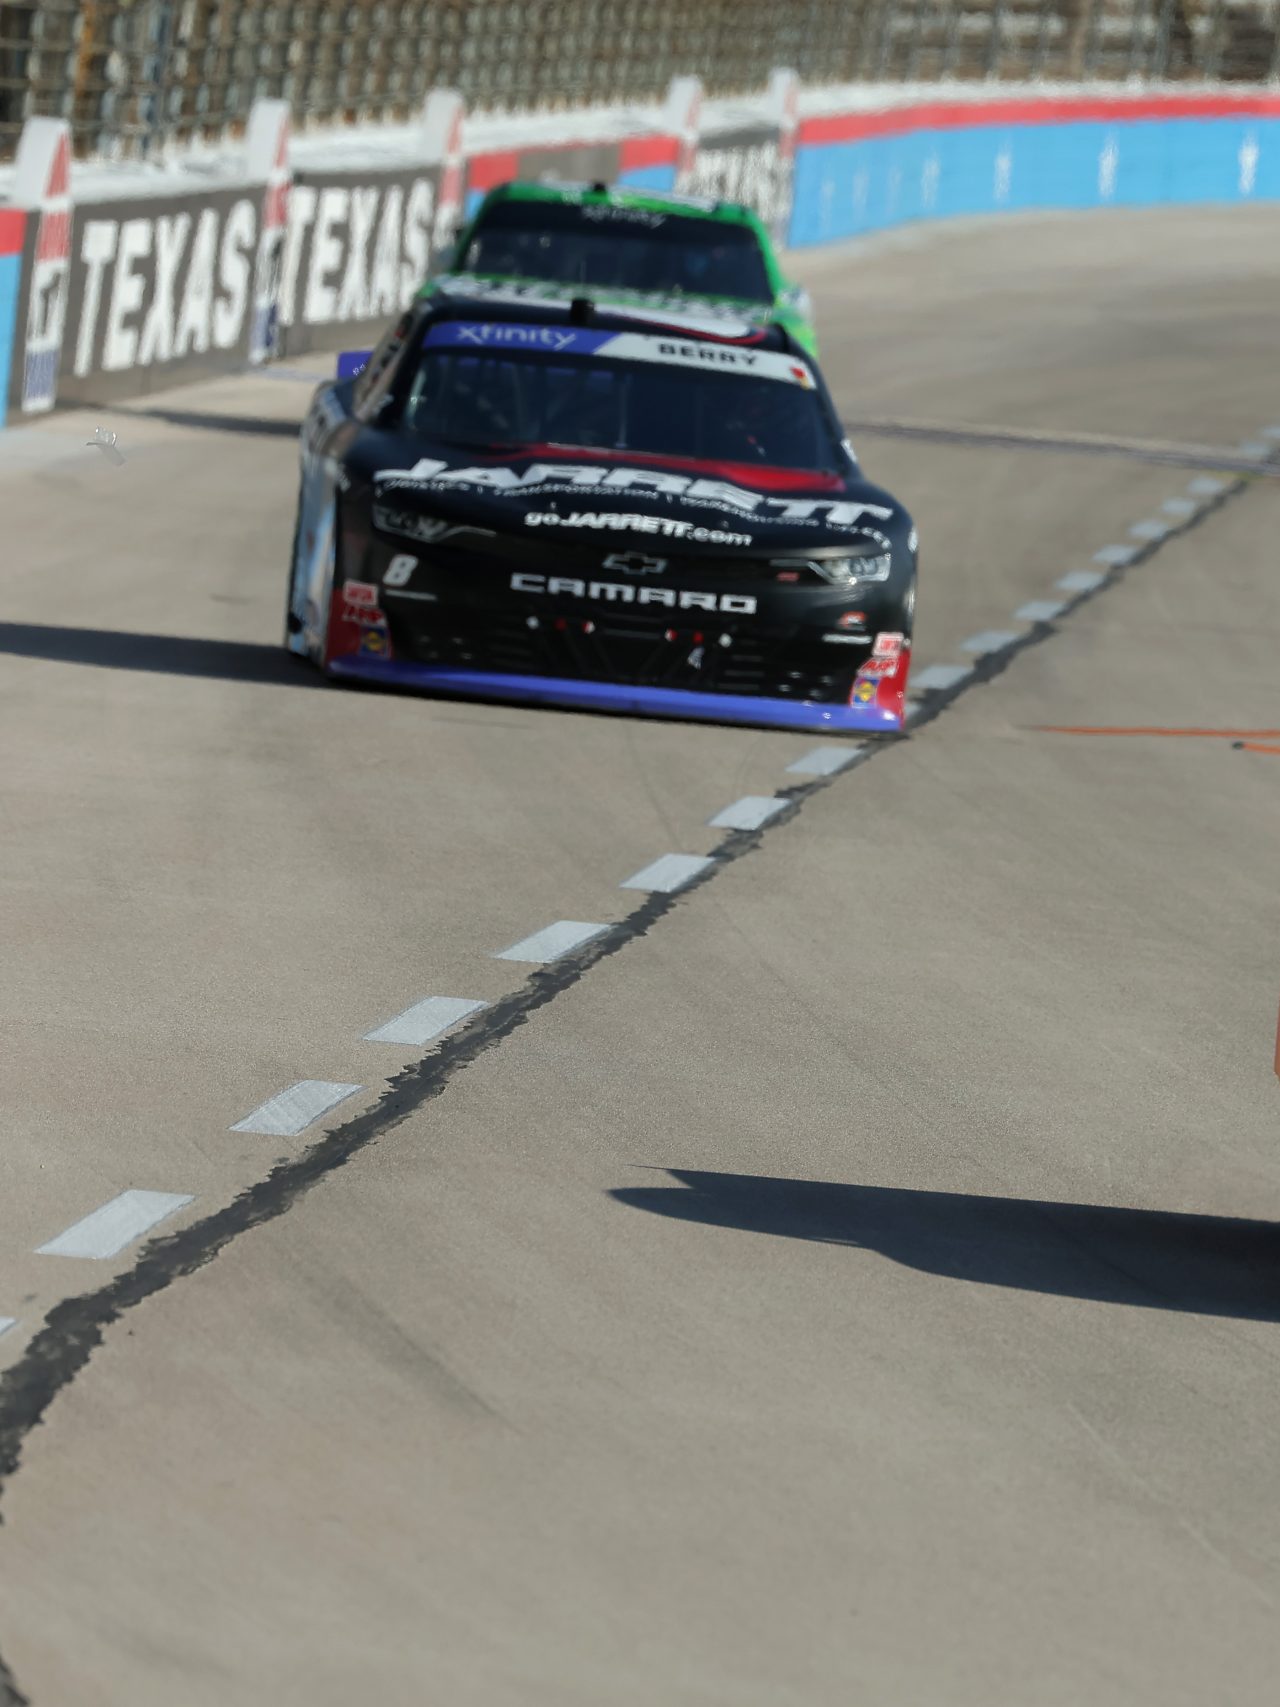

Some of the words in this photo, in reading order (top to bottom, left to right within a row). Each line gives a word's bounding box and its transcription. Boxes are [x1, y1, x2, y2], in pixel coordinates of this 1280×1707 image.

[279, 177, 435, 325] TEXAS
[74, 199, 260, 379] TEXAS
[457, 321, 578, 350] xfinity
[658, 342, 758, 368] BERRY
[373, 458, 894, 524] JARRETT
[524, 511, 753, 547] goJARRETT.com
[382, 555, 418, 587] 8
[510, 572, 757, 615] CAMARO
